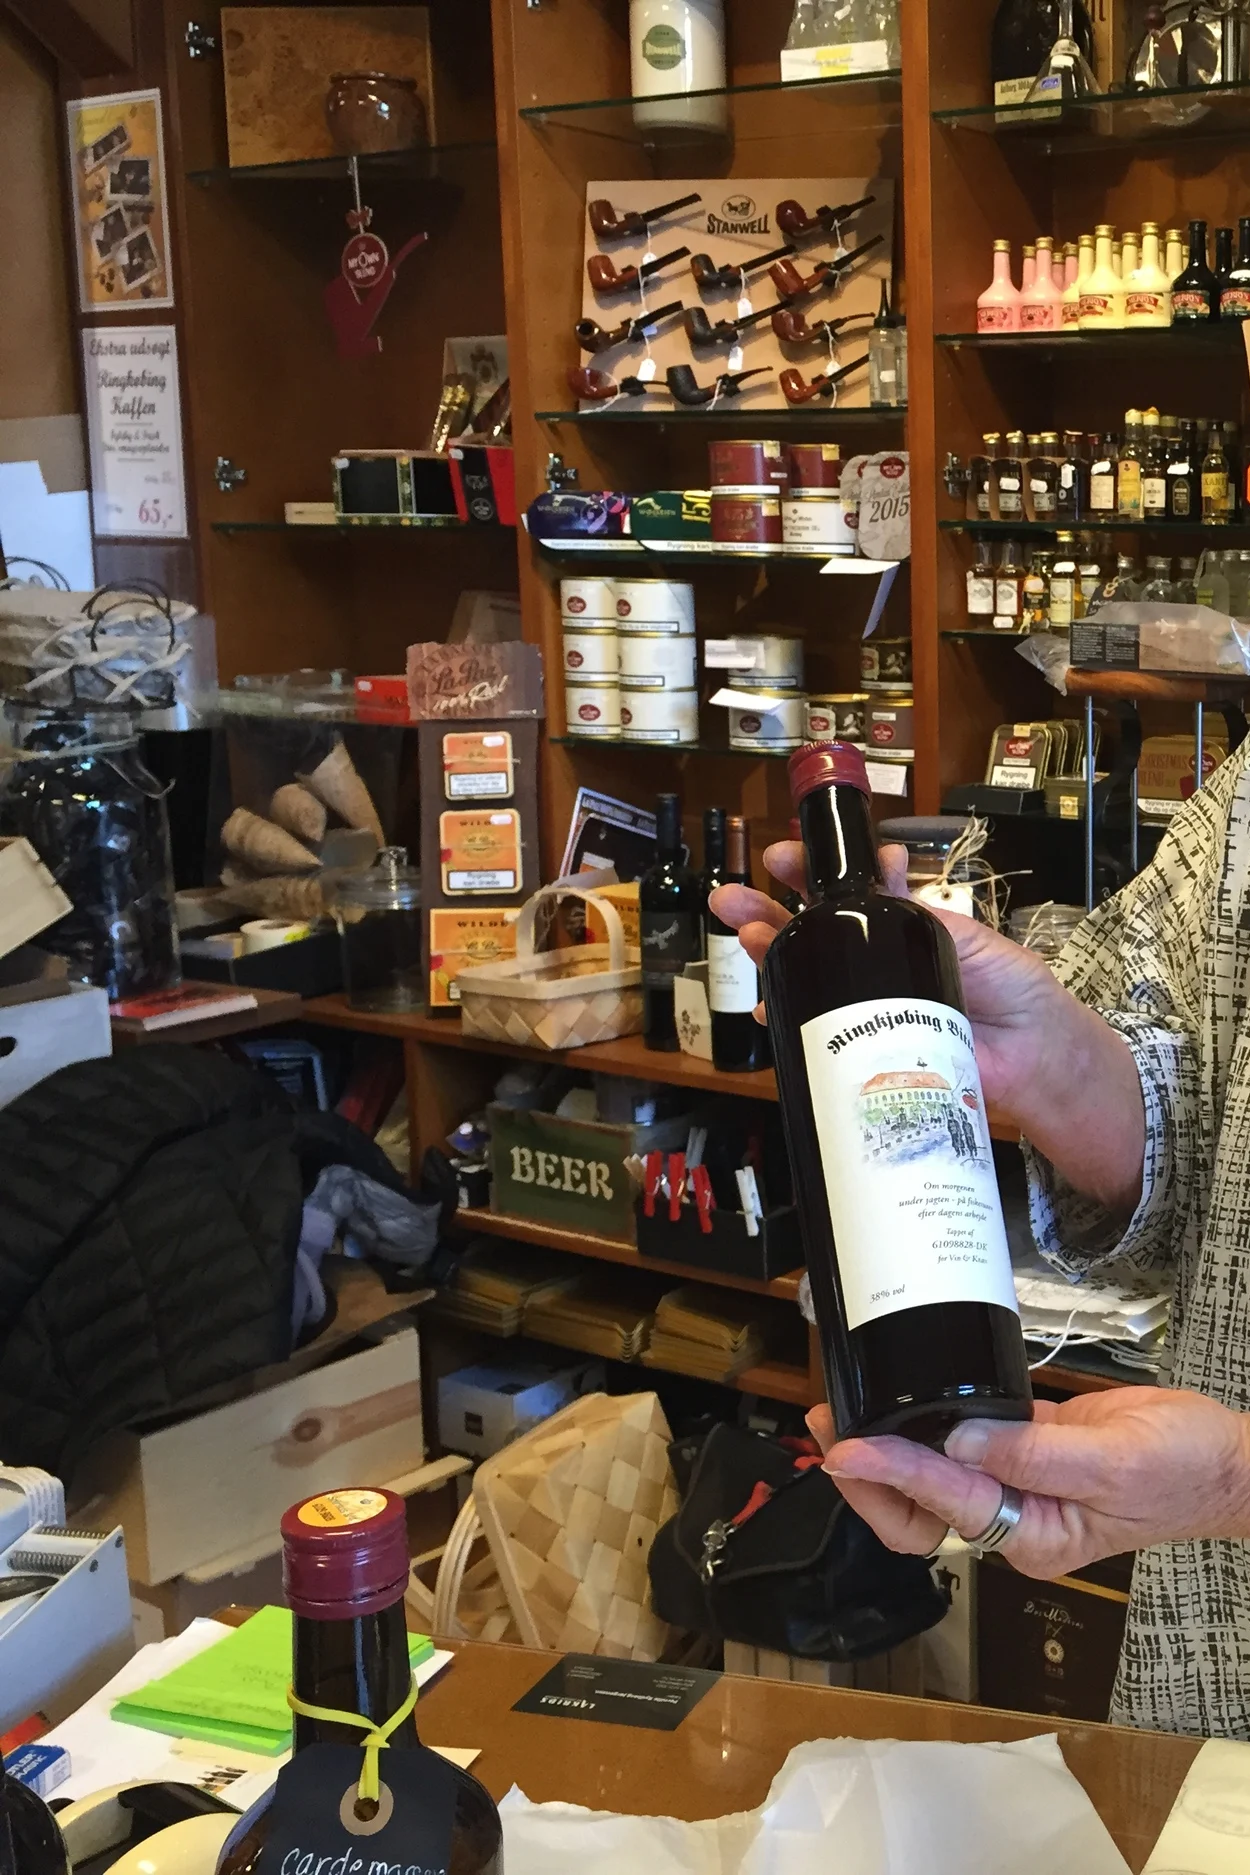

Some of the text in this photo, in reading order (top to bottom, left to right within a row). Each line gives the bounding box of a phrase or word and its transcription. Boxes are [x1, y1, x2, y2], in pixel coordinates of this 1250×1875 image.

[707, 213, 770, 234] STANWELL
[110, 396, 156, 420] Kaffen
[681, 490, 713, 524] 150
[869, 494, 911, 523] 2015
[826, 1009, 942, 1055] Ringkjøbing
[510, 1146, 614, 1200] BEER
[923, 1181, 975, 1193] Om morgenen
[899, 1196, 924, 1207] under
[925, 1196, 950, 1205] jagten
[918, 1208, 936, 1221] efter
[938, 1208, 963, 1219] dagens
[869, 1289, 890, 1304] 38%
[539, 1696, 596, 1710] LAKRIDS
